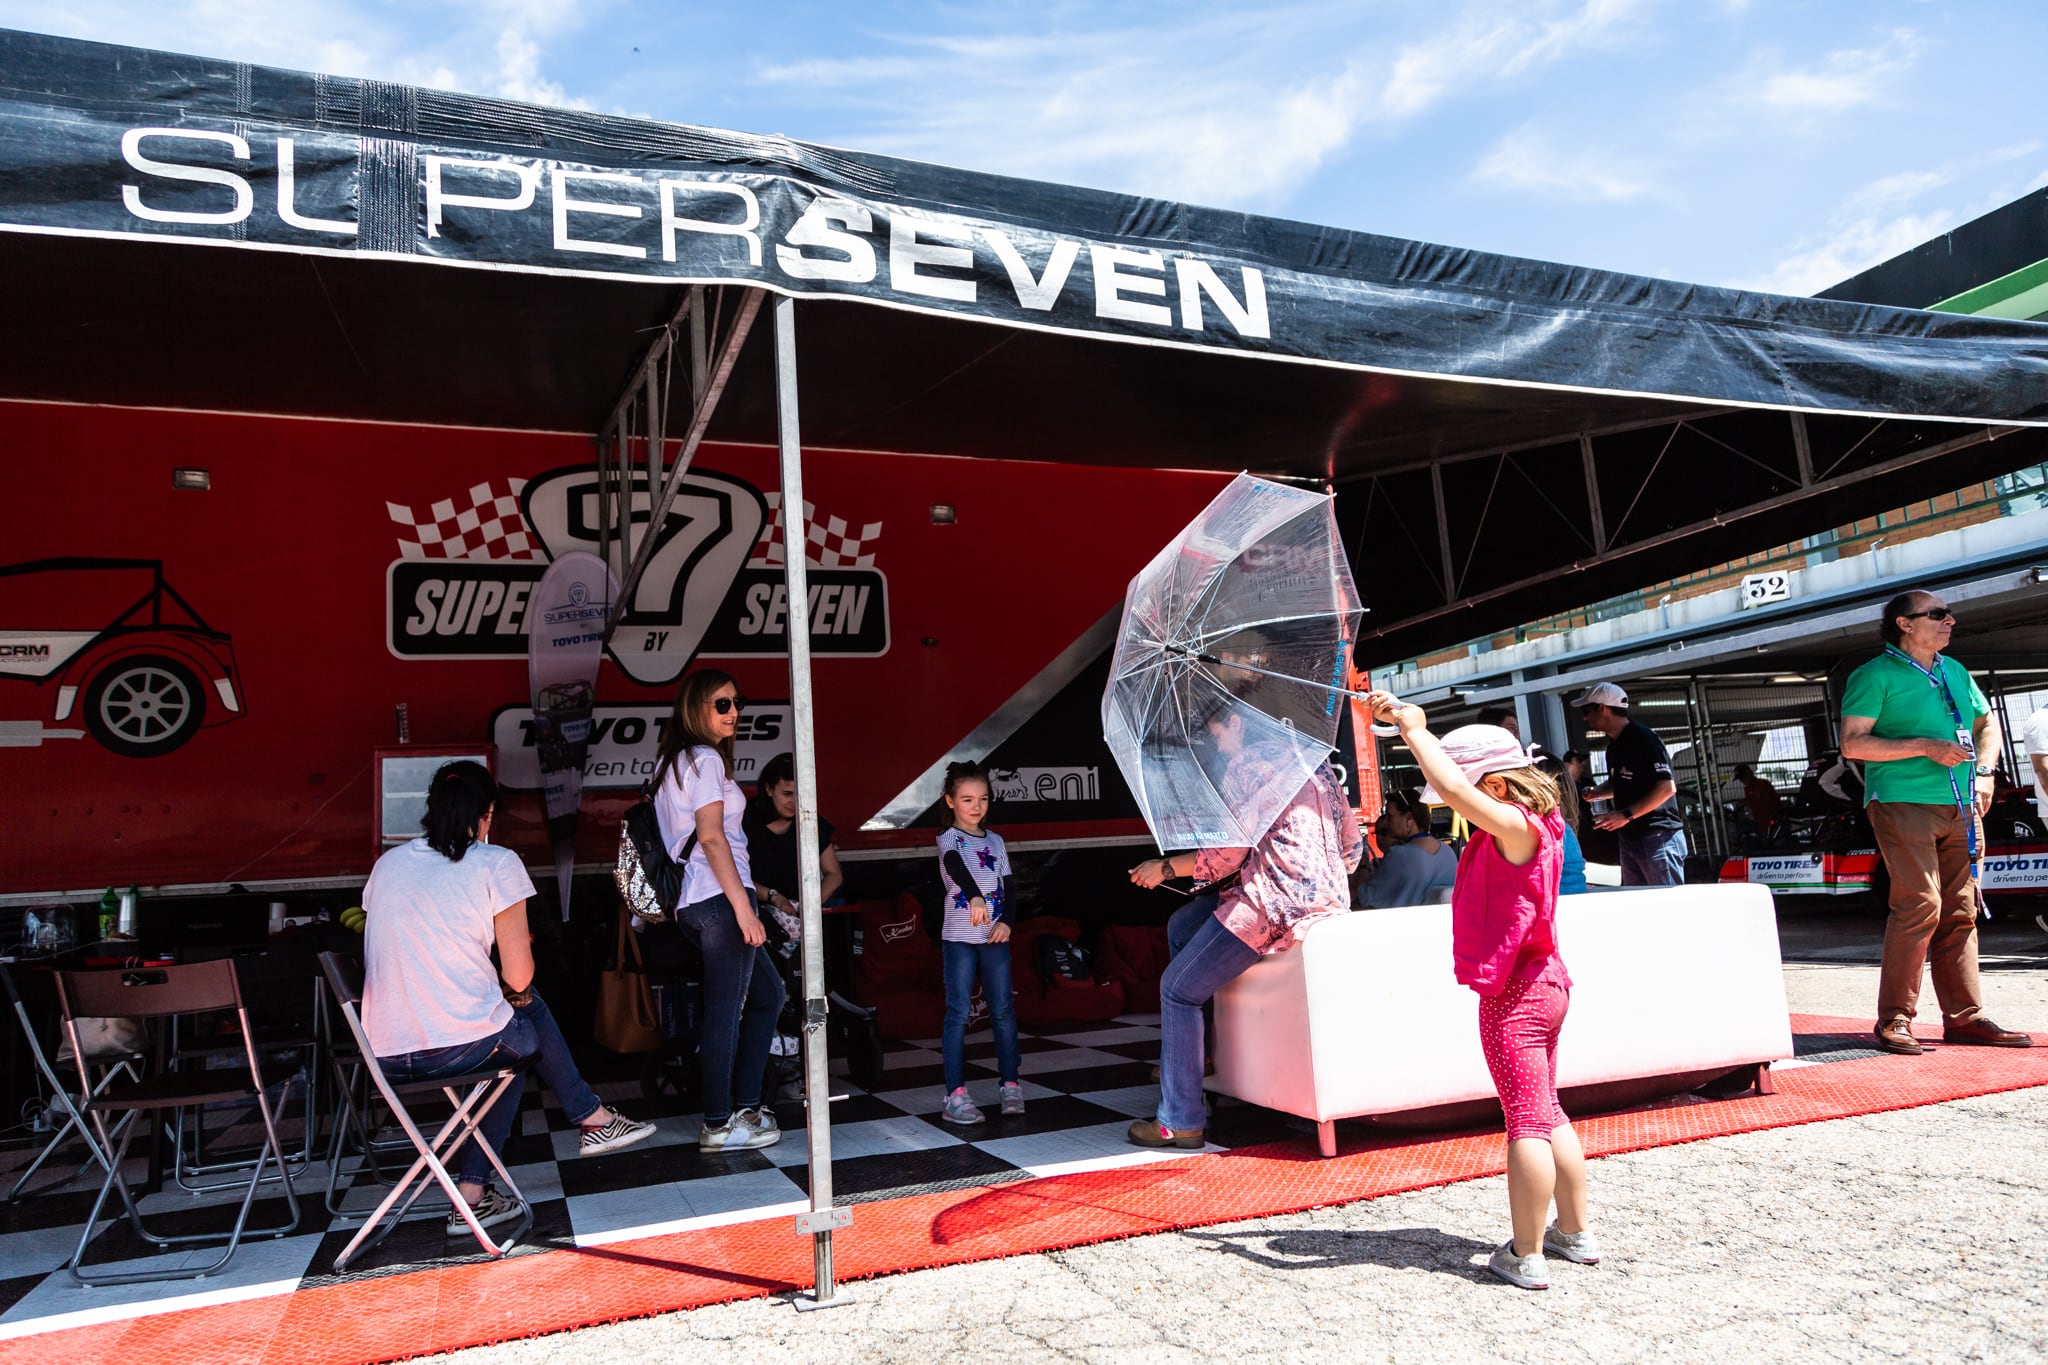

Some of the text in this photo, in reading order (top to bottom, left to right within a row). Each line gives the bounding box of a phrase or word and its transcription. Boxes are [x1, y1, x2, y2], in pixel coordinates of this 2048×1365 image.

[1750, 577, 1785, 598] 32
[544, 607, 614, 623] SUPERSEVE
[552, 635, 580, 647] TOYO
[644, 632, 669, 652] BY
[0, 645, 49, 656] CRM
[519, 716, 647, 747] TYO
[1035, 766, 1095, 801] eni
[1751, 860, 1819, 871] TOYO TIRES
[1984, 859, 2030, 872] TOYO
[1757, 871, 1777, 880] driven
[1784, 872, 1812, 881] perform
[1993, 873, 2023, 883] driven
[2024, 874, 2034, 882] to
